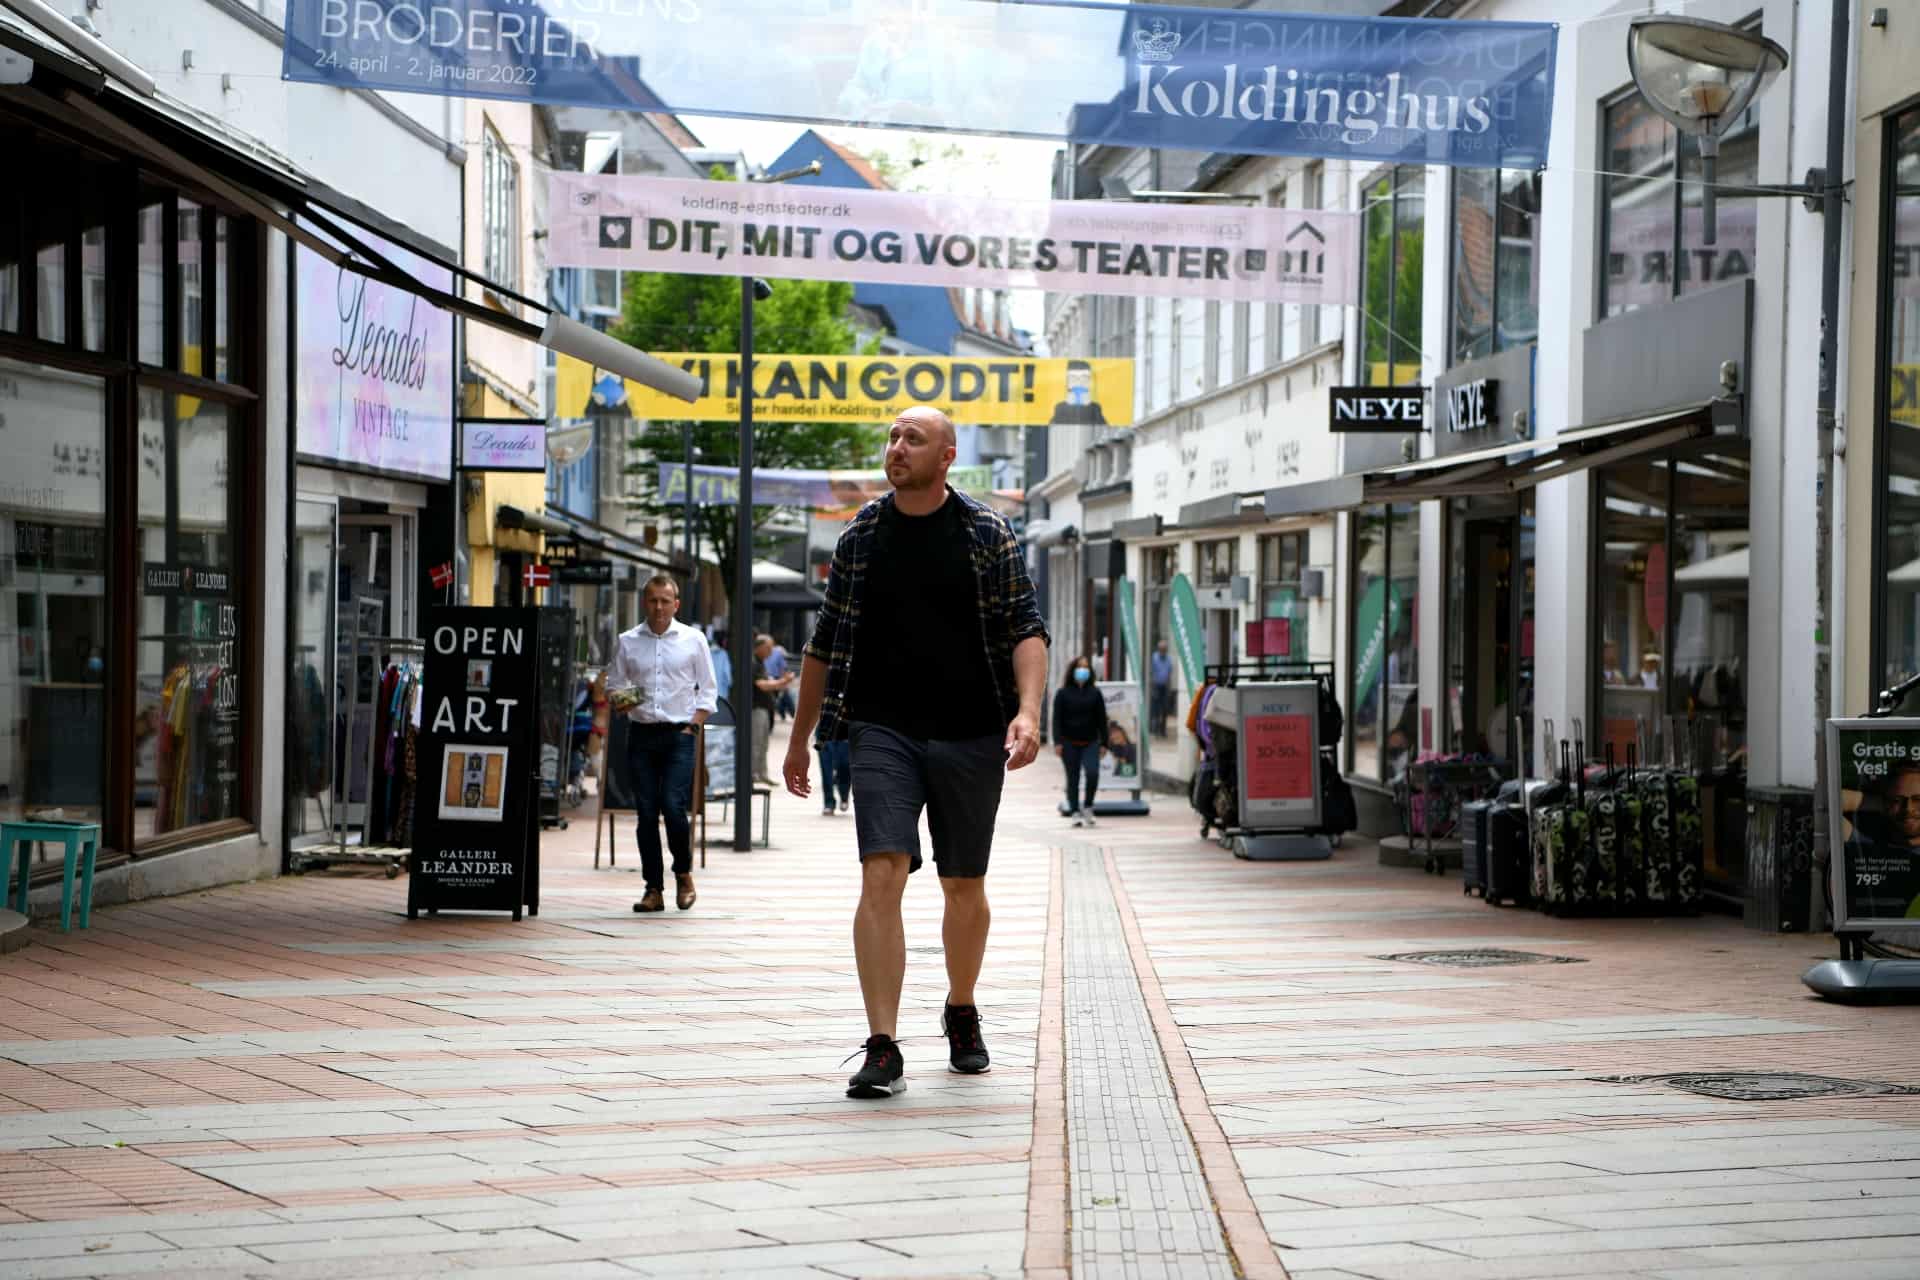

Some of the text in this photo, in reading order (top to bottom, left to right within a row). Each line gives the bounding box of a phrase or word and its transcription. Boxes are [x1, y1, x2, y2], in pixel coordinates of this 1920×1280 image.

[319, 0, 599, 61] BRODERIER
[315, 48, 344, 68] 24.
[350, 55, 388, 74] april
[407, 58, 424, 76] 2.
[427, 60, 482, 80] januar
[487, 65, 537, 85] 2022
[1131, 62, 1492, 145] Koldinghus
[681, 195, 851, 217] kolding-egnsteater.dk
[647, 216, 1229, 280] DIT, MIT OG VORES TEATER
[725, 359, 847, 400] KAN
[859, 360, 1036, 402] GODT!
[353, 398, 410, 442] VINTAGE
[726, 402, 768, 415] Sier
[772, 402, 816, 417] handel
[829, 403, 882, 419] Kolding
[1334, 397, 1423, 421] NEYE
[1447, 377, 1487, 434] NEYE
[433, 625, 525, 656] OPEN
[431, 695, 519, 735] ART
[1852, 741, 1907, 758] Gratis
[1853, 759, 1889, 776] Yes!
[421, 861, 513, 875] LEANDER
[439, 849, 497, 860] GALLERI
[1855, 873, 1881, 886] 795
